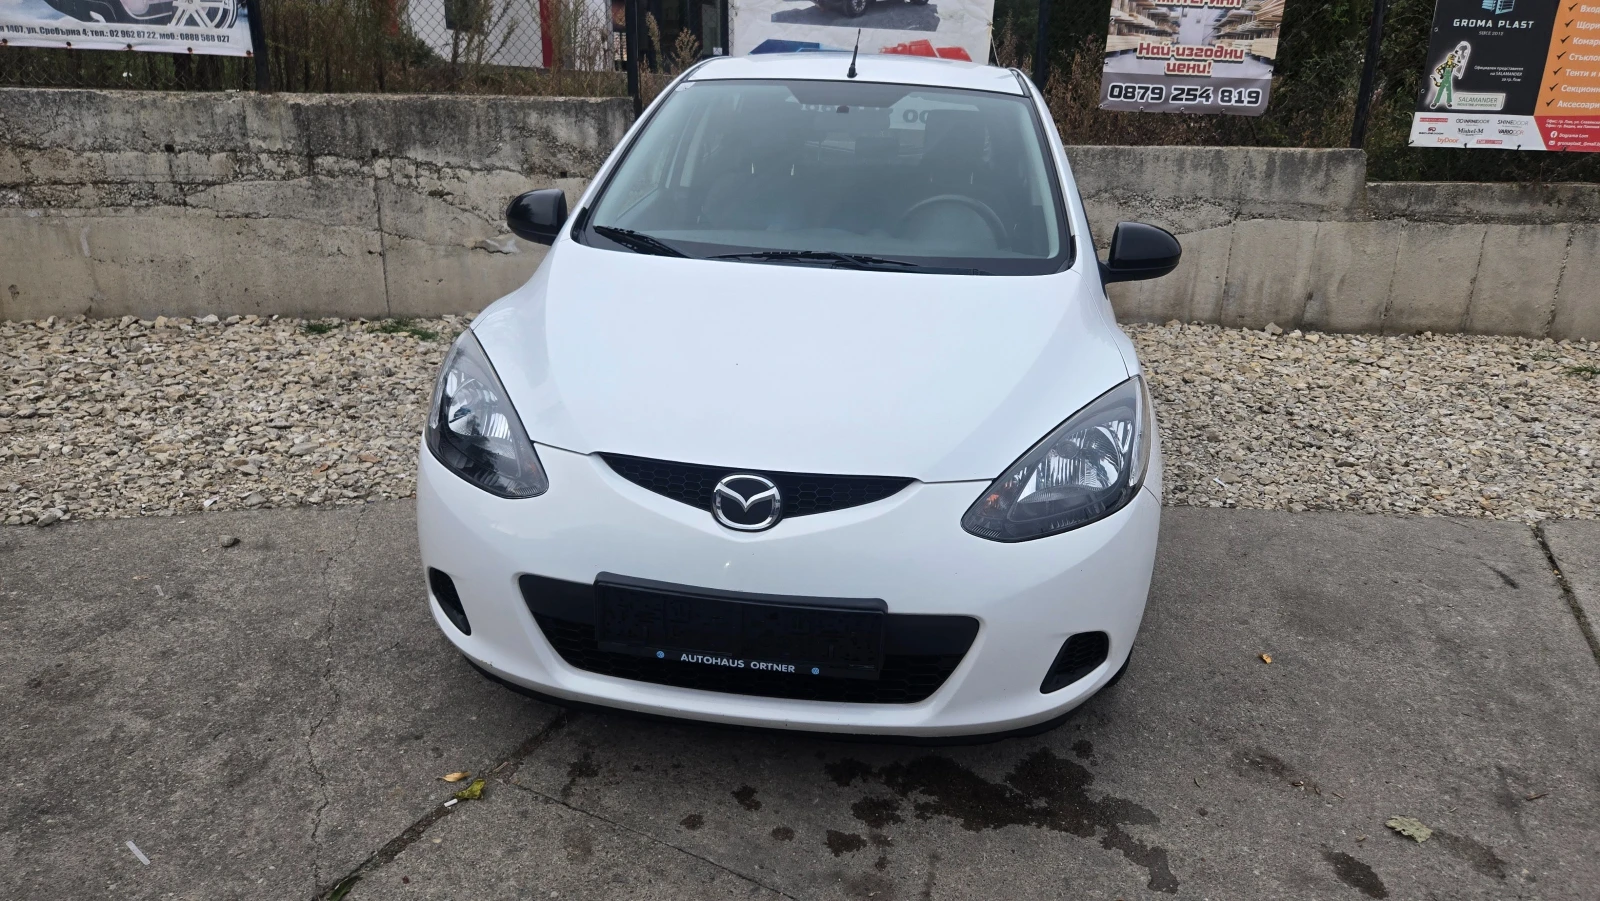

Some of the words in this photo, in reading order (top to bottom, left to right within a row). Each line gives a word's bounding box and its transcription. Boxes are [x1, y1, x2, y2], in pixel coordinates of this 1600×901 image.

[1453, 19, 1493, 28] GROMA
[1497, 20, 1535, 29] PLAST
[39, 26, 81, 36] Сребърна
[109, 29, 120, 38] 02
[121, 30, 135, 39] 962
[180, 32, 199, 42] 0888
[1138, 43, 1244, 60] Най-изгодни
[1166, 62, 1212, 74] цени!
[1566, 68, 1589, 77] Тенти
[1107, 84, 1165, 102] 0879
[1170, 87, 1212, 104] 254
[1220, 89, 1262, 106] 819
[1457, 96, 1498, 104] SALAMANDER
[1437, 136, 1459, 144] byDoor
[680, 653, 745, 668] AUTOHAUS
[750, 661, 796, 673] ORTNER
